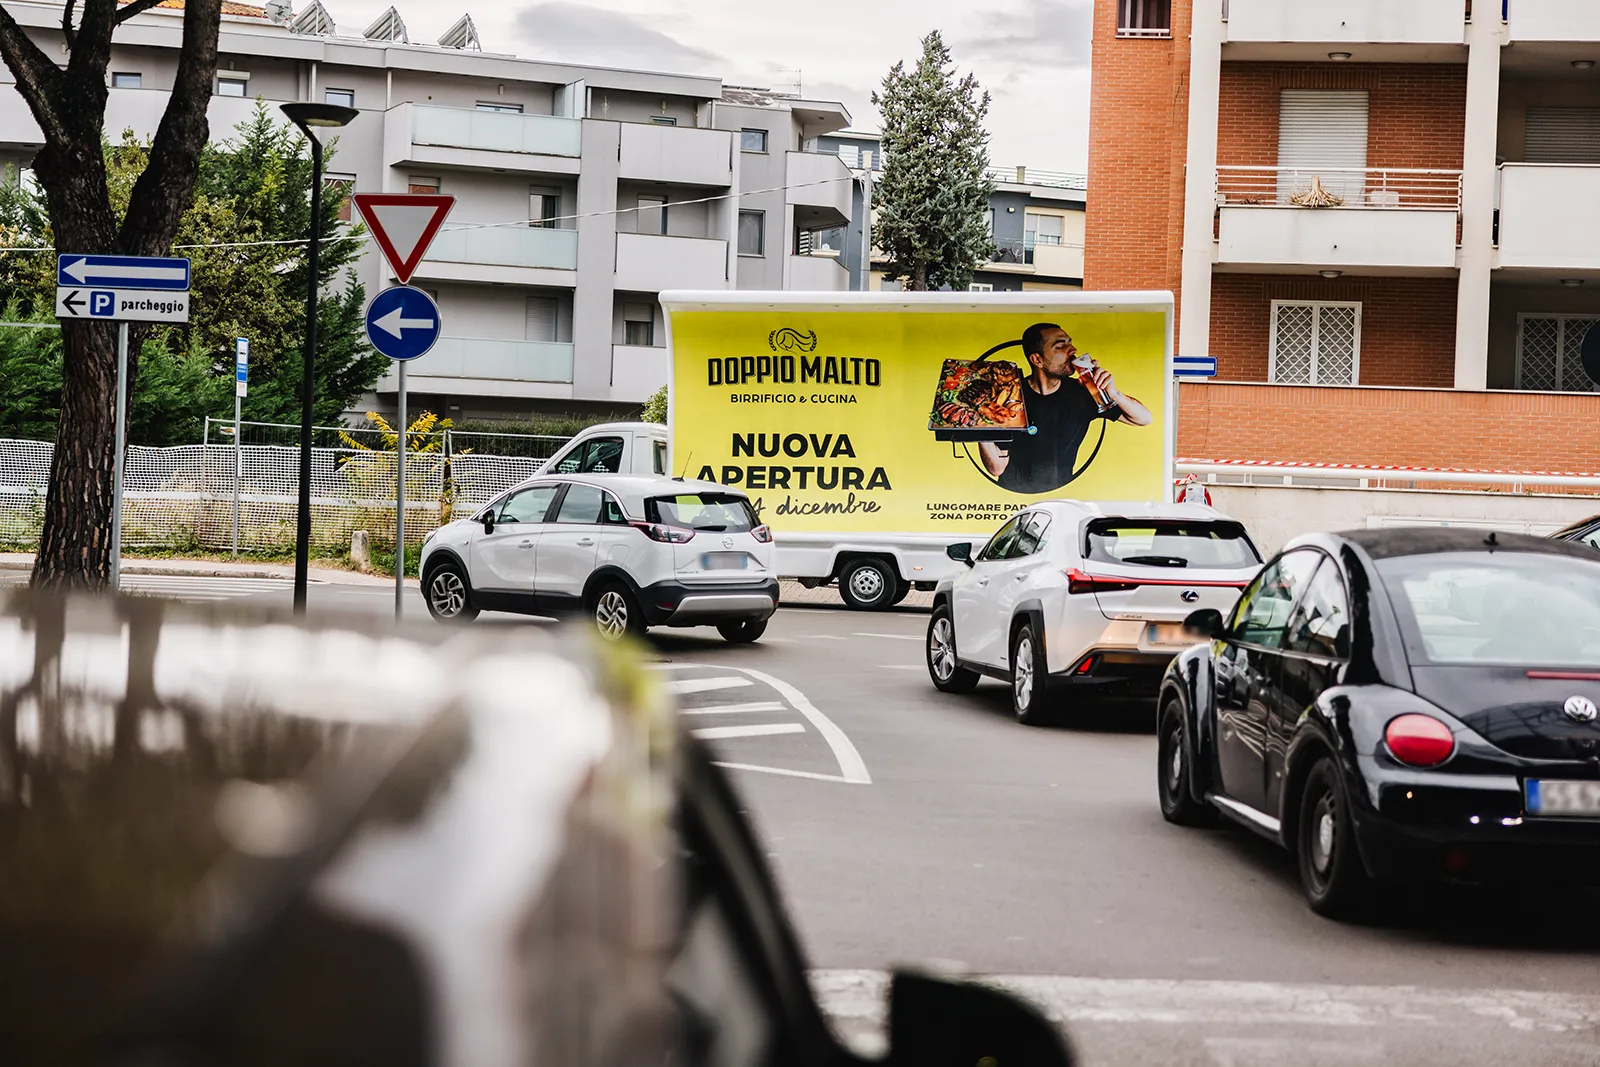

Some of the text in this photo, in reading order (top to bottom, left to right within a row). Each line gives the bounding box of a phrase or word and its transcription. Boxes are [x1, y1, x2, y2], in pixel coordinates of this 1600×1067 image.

[95, 294, 184, 314] P parcheggio
[707, 355, 881, 387] DOPPIO MALTO
[730, 393, 796, 403] BIRRIFICIO
[811, 394, 857, 404] CUCINA
[732, 432, 856, 458] NUOVA
[697, 465, 892, 490] APERTURA
[776, 492, 882, 516] dicembre
[926, 503, 1001, 512] LUNGOMARE
[966, 513, 1008, 521] PORTO
